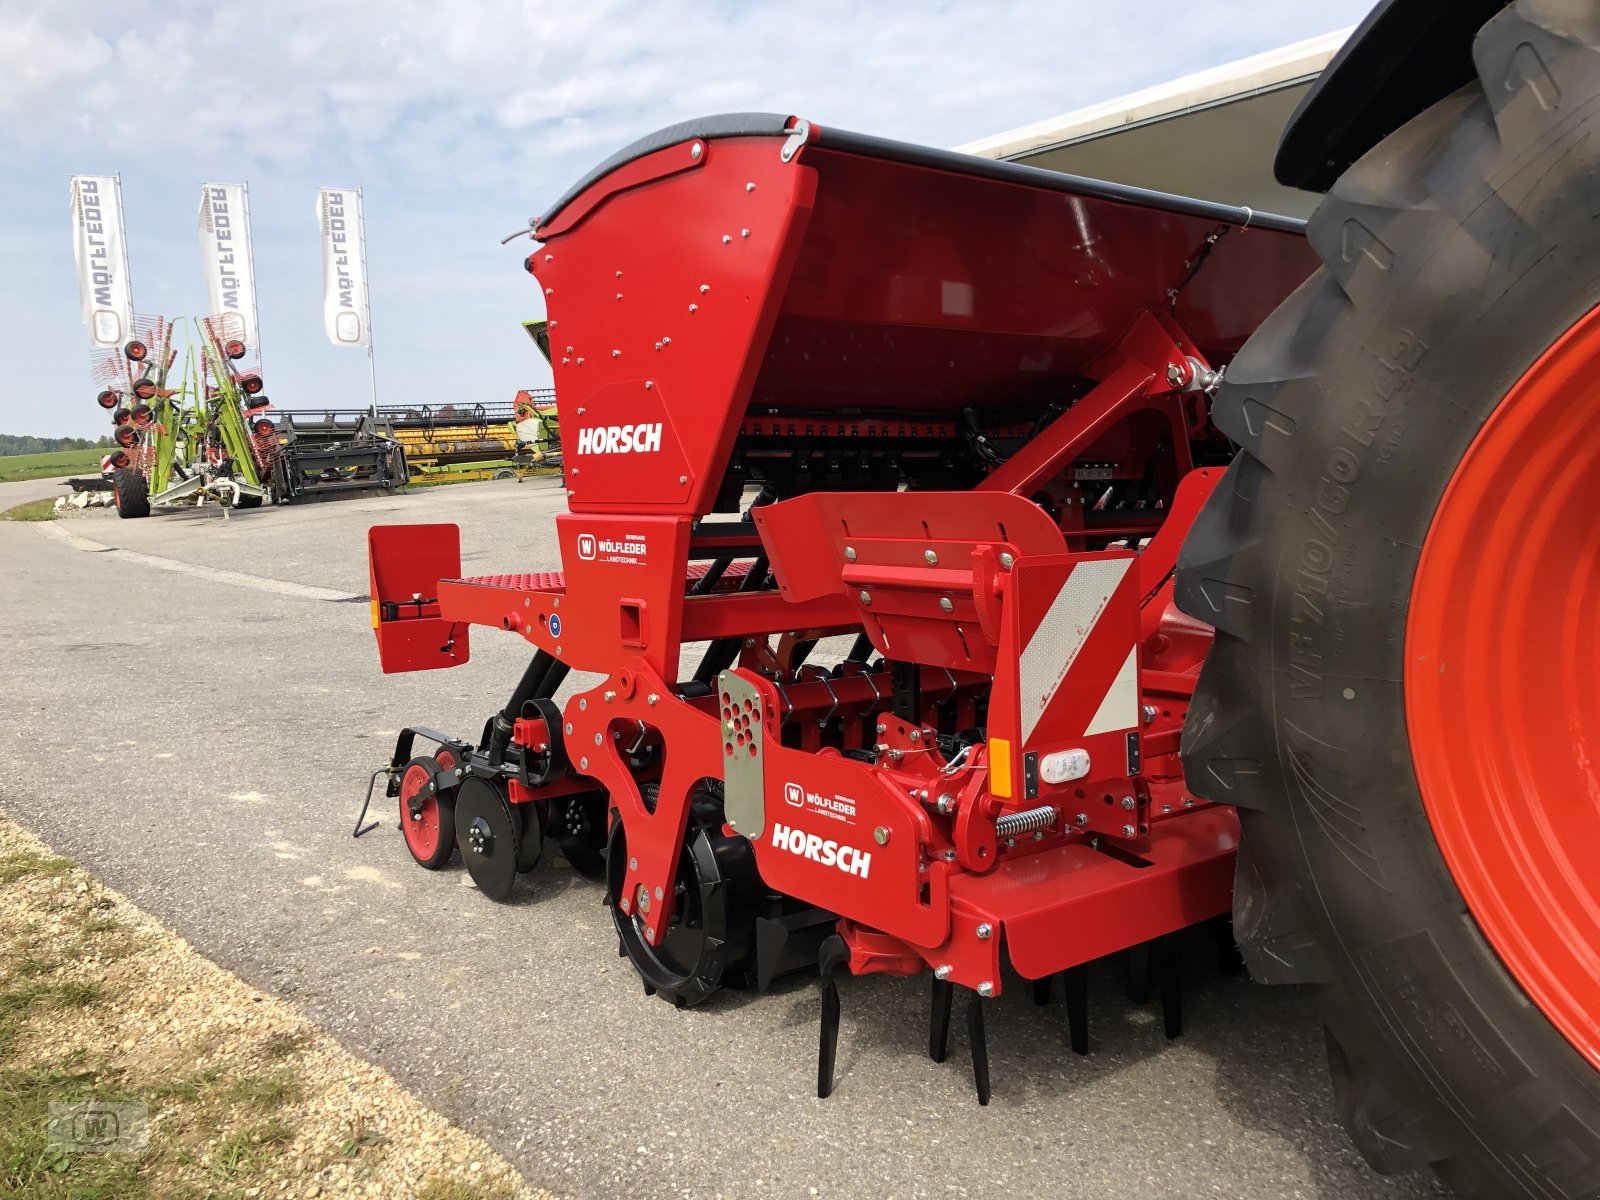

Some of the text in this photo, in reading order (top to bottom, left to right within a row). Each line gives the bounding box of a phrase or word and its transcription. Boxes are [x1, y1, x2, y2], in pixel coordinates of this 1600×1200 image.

[577, 422, 663, 455] HORSCH
[582, 540, 591, 554] W
[599, 539, 646, 554] WÖLFLEDER
[607, 556, 637, 564] LANDTECHNIK
[789, 788, 799, 802] W
[807, 793, 855, 816] WÖLFLEDER
[815, 808, 846, 821] LANDTECHNIK
[771, 822, 872, 879] HORSCH
